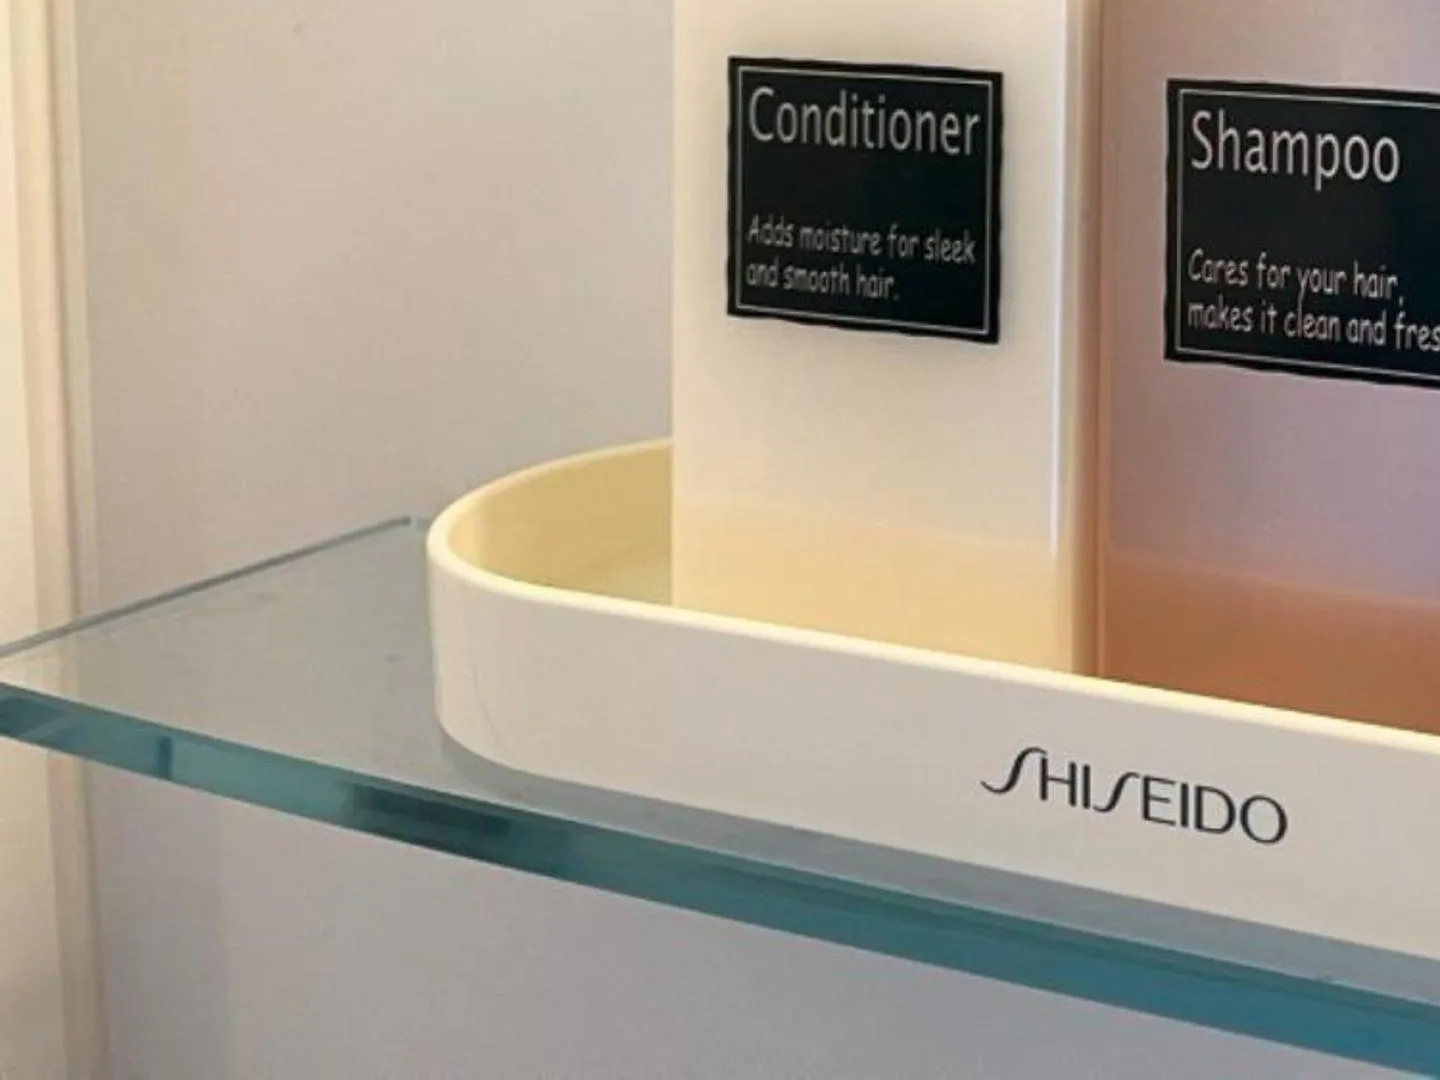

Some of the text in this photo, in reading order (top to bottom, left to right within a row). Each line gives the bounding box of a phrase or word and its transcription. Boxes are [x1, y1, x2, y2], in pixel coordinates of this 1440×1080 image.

[750, 86, 980, 155] Conditioner
[1191, 108, 1400, 192] Shampoo
[748, 215, 976, 264] Adds moisture for sleek
[746, 258, 899, 300] and smooth hair.
[1188, 248, 1404, 305] Cares for your hair,
[1188, 294, 1253, 333] makes
[1261, 300, 1277, 334] it
[1284, 300, 1340, 341] clean
[1347, 311, 1386, 347] and
[980, 746, 1288, 845] SHISEIDO
